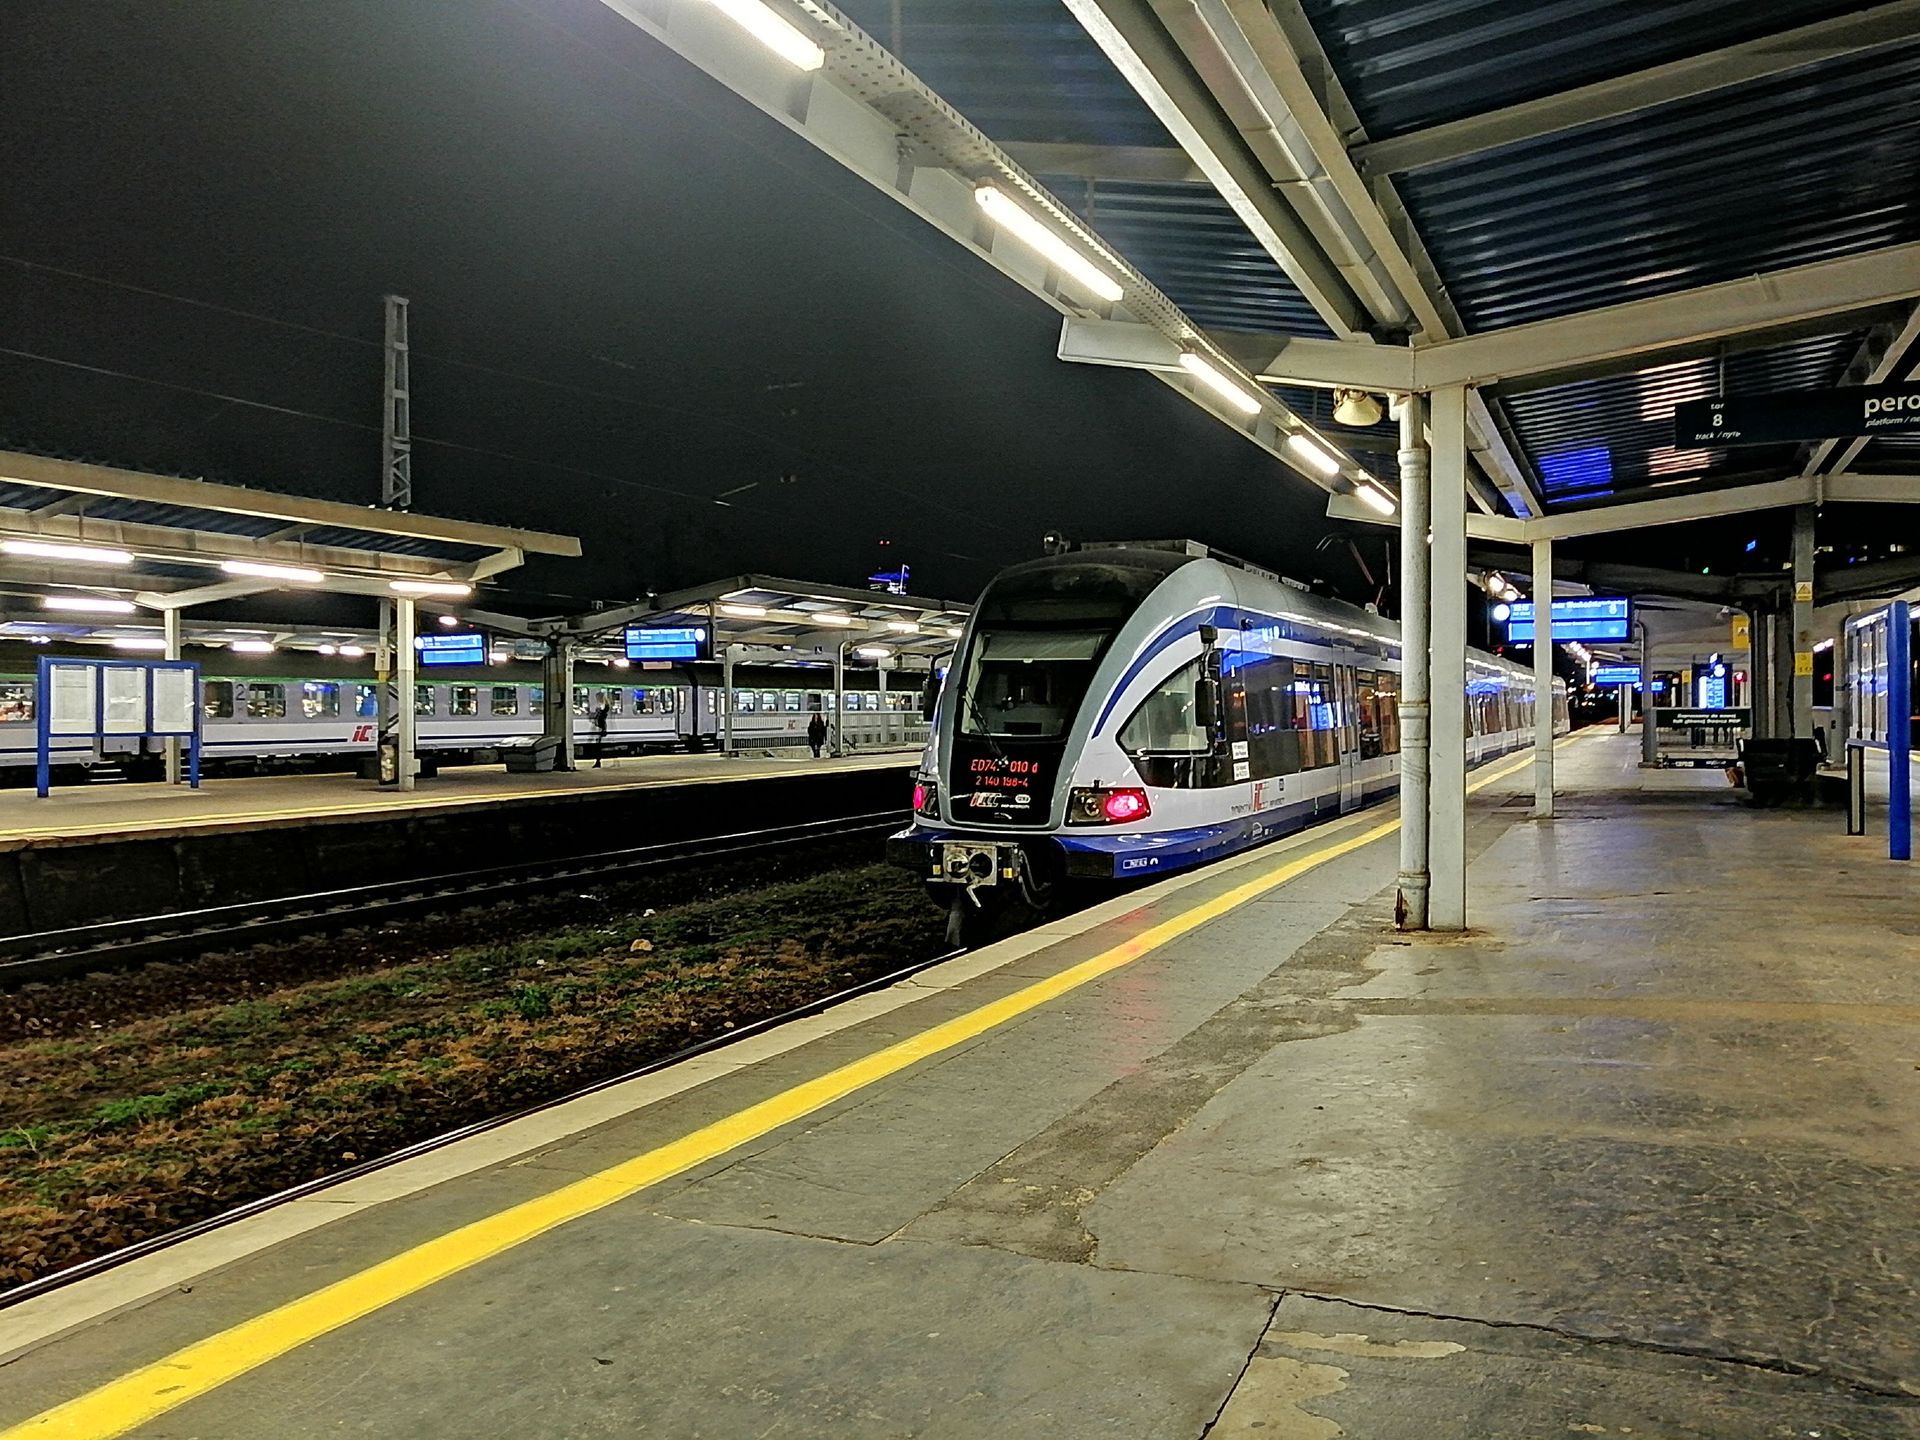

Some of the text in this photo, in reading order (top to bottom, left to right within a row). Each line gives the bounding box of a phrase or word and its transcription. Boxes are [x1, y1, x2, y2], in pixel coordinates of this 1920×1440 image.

[1712, 413, 1723, 427] 8
[1864, 417, 1903, 428] platform
[1695, 431, 1714, 440] track
[235, 683, 245, 701] 2
[985, 775, 1000, 786] 140
